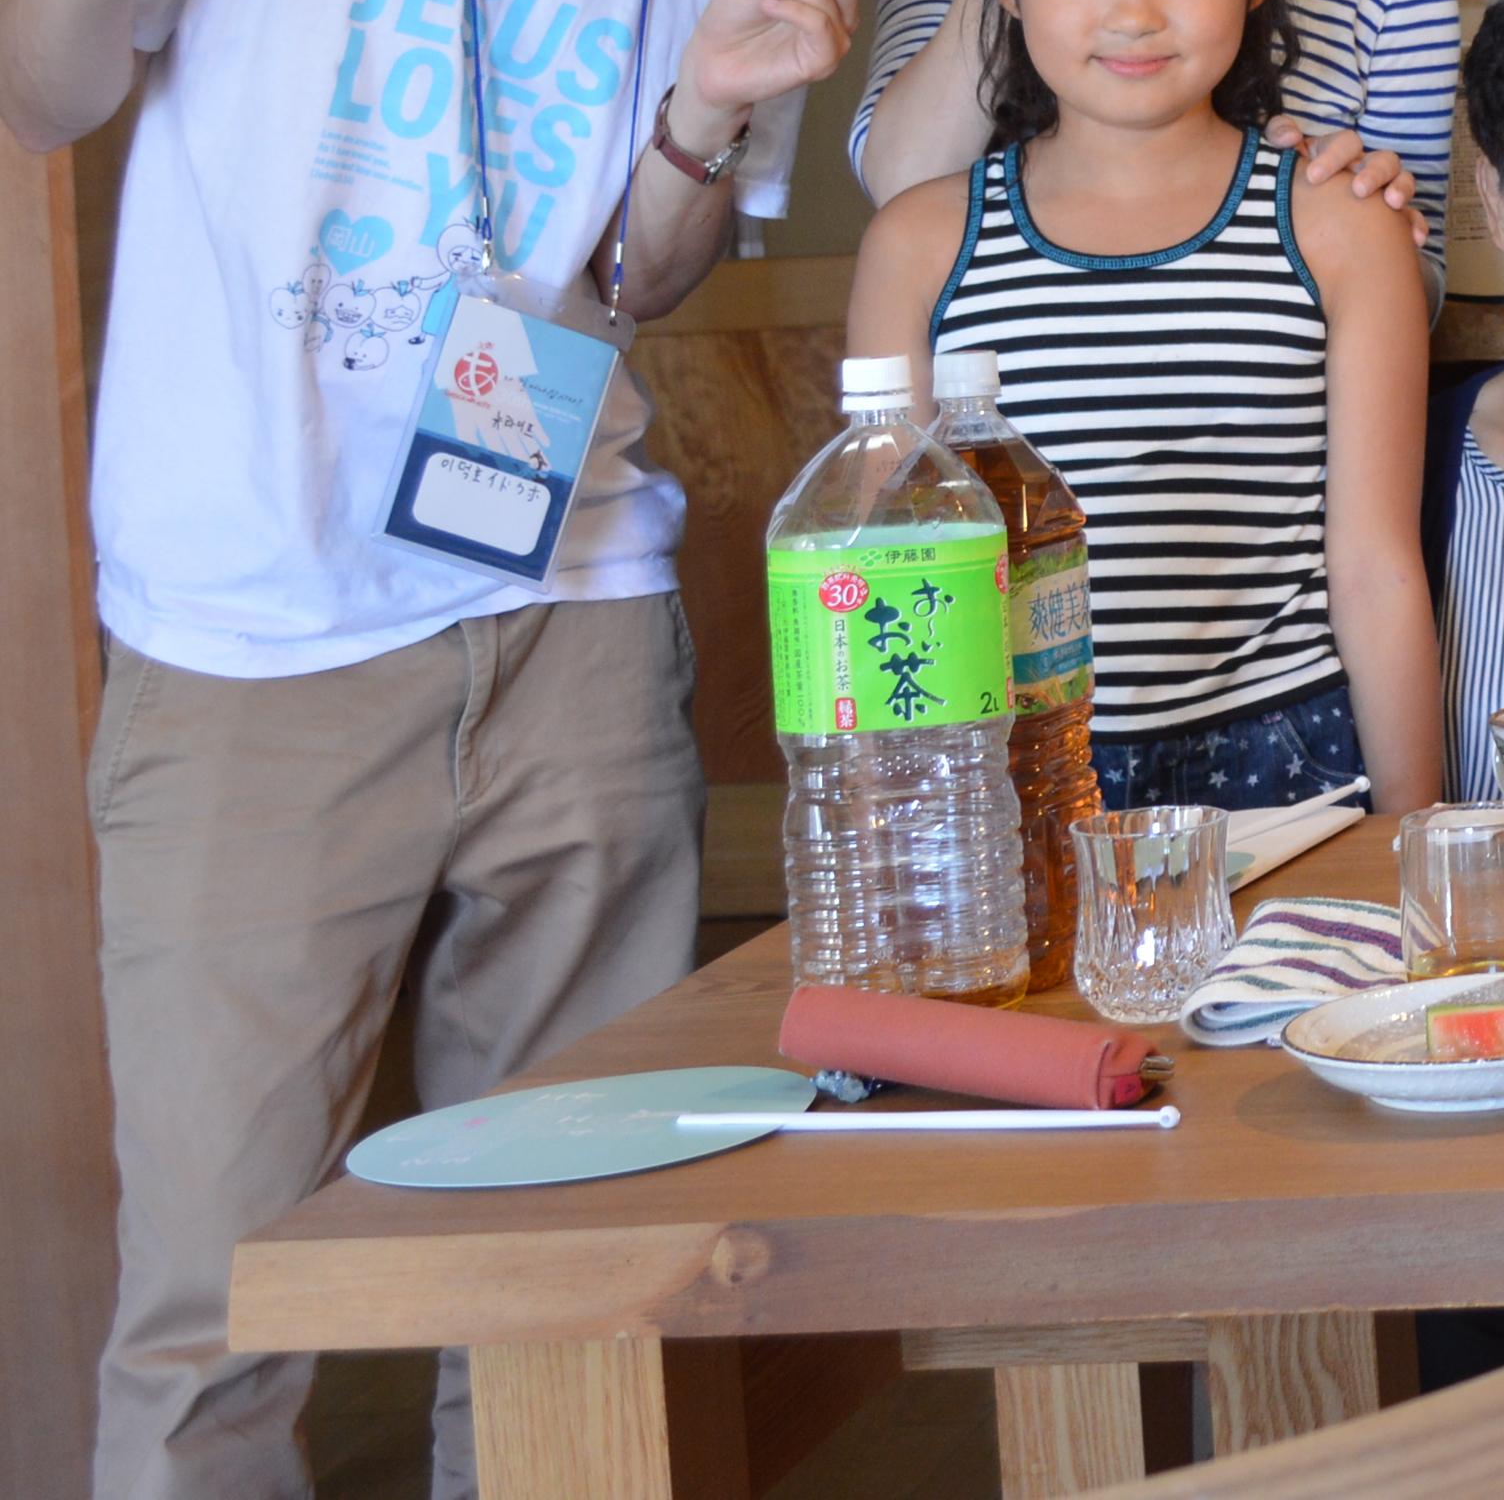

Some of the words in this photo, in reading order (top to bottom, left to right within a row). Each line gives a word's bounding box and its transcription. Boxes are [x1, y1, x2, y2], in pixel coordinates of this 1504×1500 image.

[419, 153, 556, 272] YU
[884, 547, 936, 564] 伊藤園
[826, 583, 859, 607] 30
[834, 618, 851, 691] 日本のお茶
[864, 597, 948, 722] お茶
[838, 700, 854, 729] 緑茶
